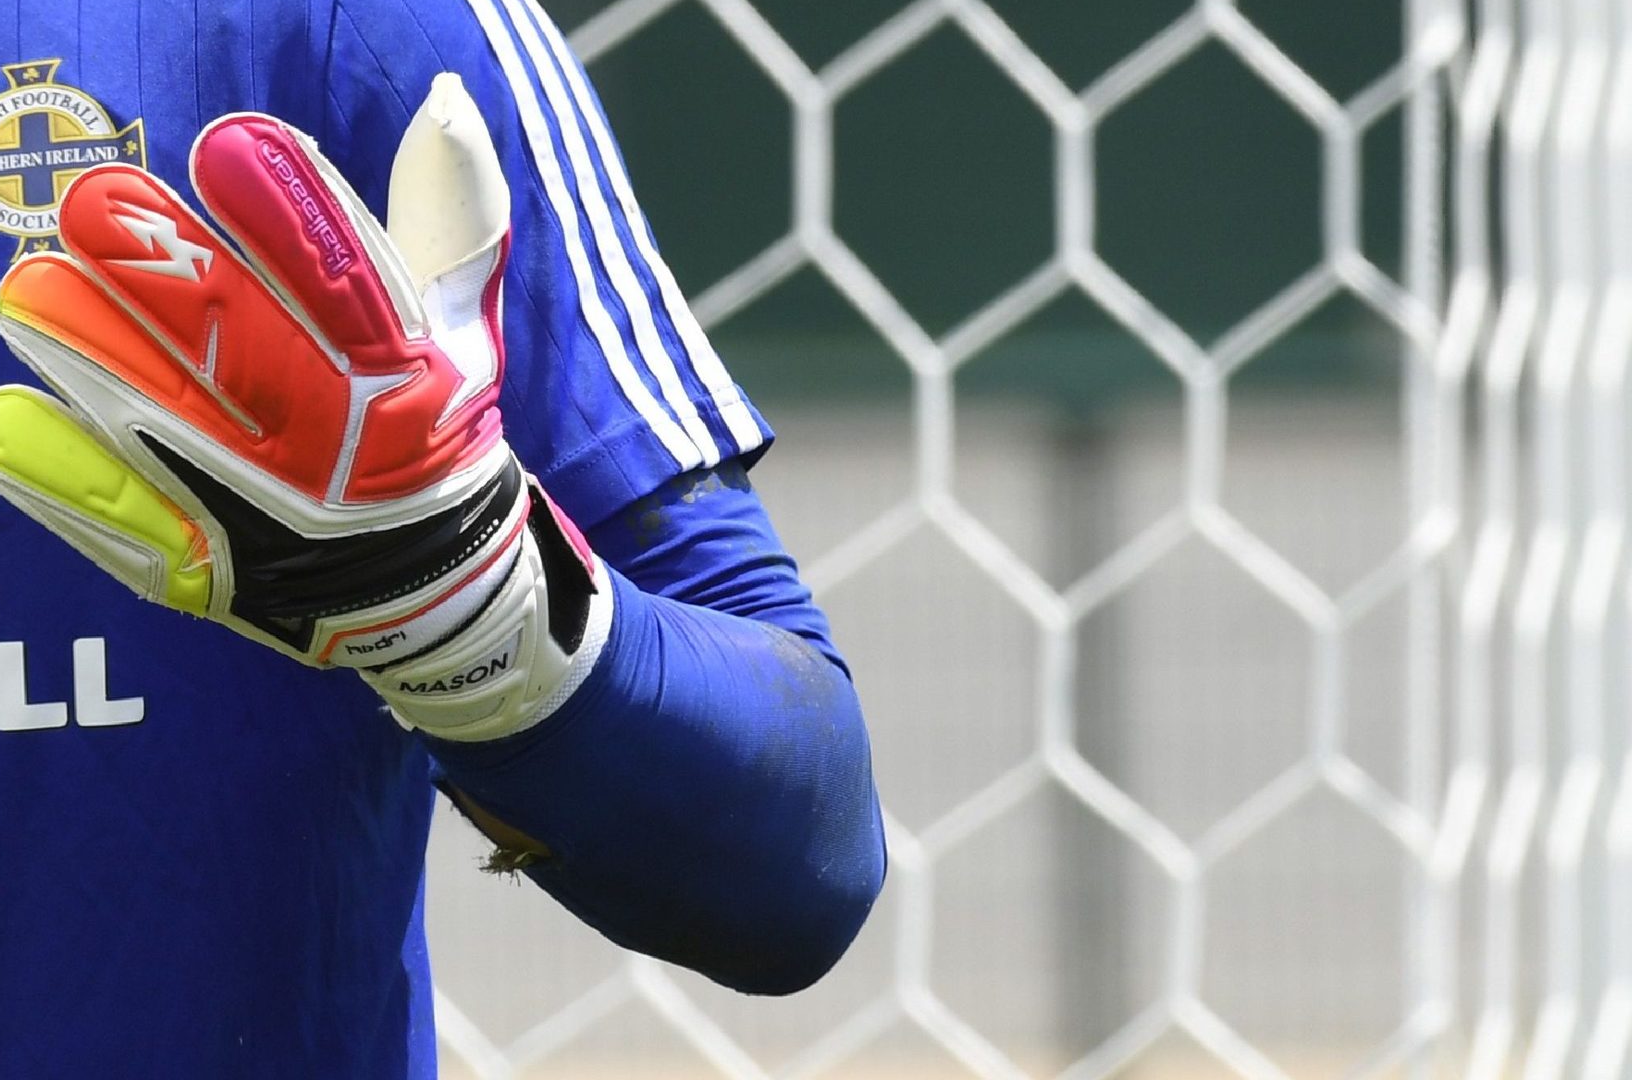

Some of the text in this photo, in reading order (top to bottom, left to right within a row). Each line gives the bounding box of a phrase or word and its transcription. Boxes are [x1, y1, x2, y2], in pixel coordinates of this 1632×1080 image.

[11, 91, 100, 131] FOOTBALL
[45, 145, 119, 166] IRELAND
[399, 652, 509, 693] MASON
